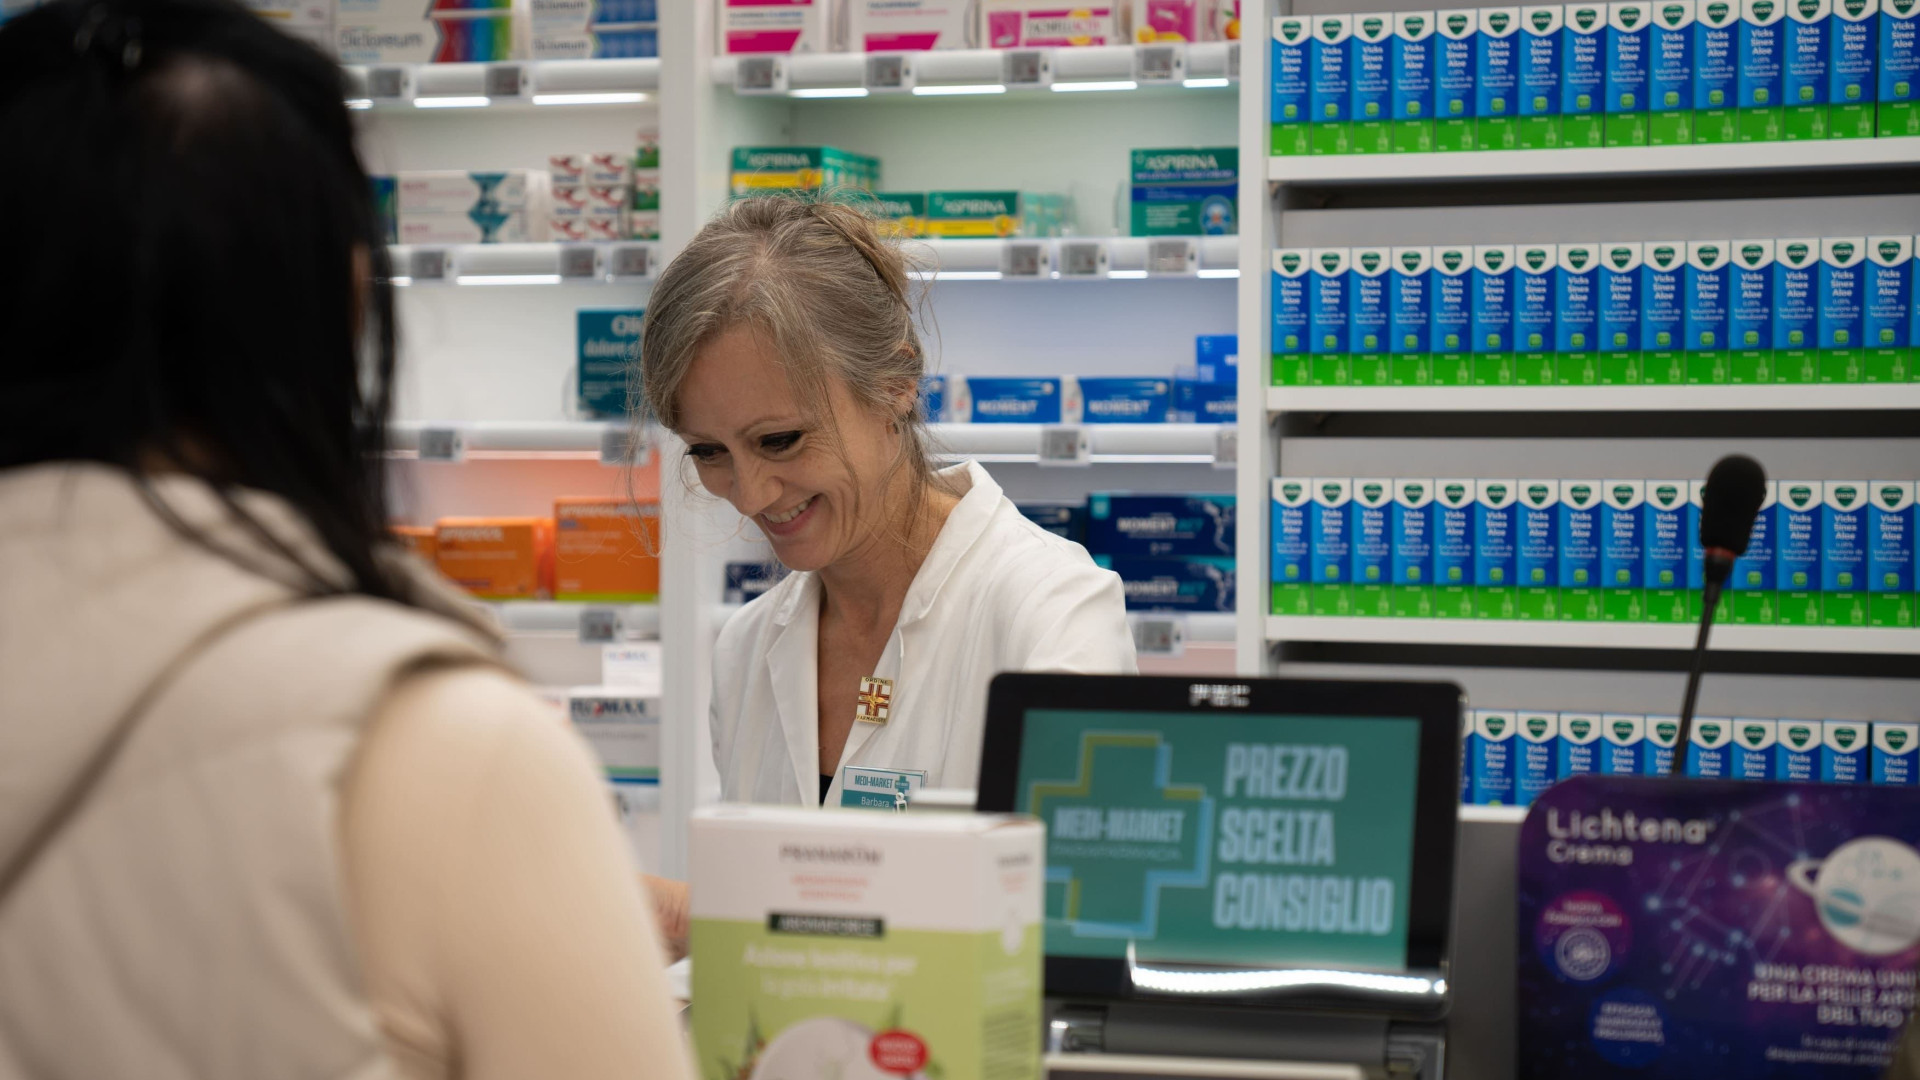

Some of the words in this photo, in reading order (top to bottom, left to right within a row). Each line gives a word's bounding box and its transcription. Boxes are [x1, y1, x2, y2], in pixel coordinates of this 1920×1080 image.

[1844, 25, 1866, 34] Vicks
[1892, 22, 1915, 31] Vicks
[1706, 32, 1729, 40] Vicks
[1751, 29, 1774, 38] Vicks
[1797, 27, 1820, 36] Vicks
[1892, 31, 1915, 40] Sinex
[1574, 37, 1596, 46] Vicks
[1618, 36, 1640, 44] Vicks
[1662, 33, 1684, 42] Vicks
[1796, 36, 1820, 44] Sinex
[1843, 33, 1866, 42] Sinex
[1447, 43, 1468, 51] Vicks
[1531, 39, 1552, 48] Vicks
[1706, 40, 1729, 49] Sinex
[1751, 38, 1774, 47] Sinex
[1893, 40, 1914, 48] Aloe
[1362, 46, 1383, 54] Vicks
[1707, 49, 1727, 57] Aloe
[1752, 47, 1772, 55] Aloe
[1576, 54, 1595, 62] Aloe
[1619, 53, 1638, 61] Aloe
[1663, 51, 1682, 59] Aloe
[1448, 59, 1466, 67] Aloe
[1532, 56, 1551, 64] Aloe
[747, 153, 810, 168] ASPIRINA
[1145, 154, 1218, 170] ASPIRINA
[942, 200, 1007, 215] ASPIRINA
[1697, 274, 1719, 283] Vicks
[1741, 273, 1764, 282] Vicks
[1786, 272, 1808, 281] Vicks
[1832, 271, 1854, 280] Vicks
[1878, 270, 1900, 279] Vicks
[1320, 280, 1341, 288] Vicks
[1401, 279, 1422, 288] Vicks
[1484, 278, 1505, 286] Vicks
[1610, 276, 1632, 285] Vicks
[1653, 275, 1675, 284] Vicks
[1831, 280, 1854, 288] Sinex
[1877, 279, 1900, 287] Sinex
[1696, 283, 1719, 291] Sinex
[1741, 282, 1764, 290] Sinex
[1785, 281, 1808, 289] Sinex
[1485, 294, 1504, 302] Aloe
[1654, 292, 1674, 300] Aloe
[1698, 291, 1718, 299] Aloe
[1322, 296, 1340, 304] Aloe
[977, 400, 1038, 414] MOMENT
[1089, 400, 1150, 414] MOMENT
[1789, 515, 1812, 524] Vicks
[1834, 515, 1857, 524] Vicks
[1880, 515, 1903, 524] Vicks
[1790, 532, 1810, 540] Aloe
[1835, 532, 1855, 540] Aloe
[1882, 532, 1902, 540] Aloe
[864, 676, 888, 685] ORDINE
[1744, 753, 1766, 762] Vicks
[1788, 755, 1811, 764] Vicks
[1223, 742, 1348, 801] PREZZO
[855, 774, 893, 789] MEDI-MARKET
[861, 796, 890, 808] Barbara
[1052, 807, 1186, 844] MEDI-MARKET
[1547, 808, 1708, 844] Lichtena
[1218, 807, 1335, 866] SCELTA
[1547, 841, 1634, 867] Crema
[1212, 872, 1395, 936] CONSIGLIO
[1754, 963, 1800, 983] UNA
[1801, 964, 1875, 987] CREMA
[1747, 981, 1786, 1002] PER
[1788, 984, 1816, 1004] LA
[1817, 986, 1875, 1006] PELLE
[1817, 1004, 1857, 1025] DEL
[1859, 1006, 1904, 1028] TUO
